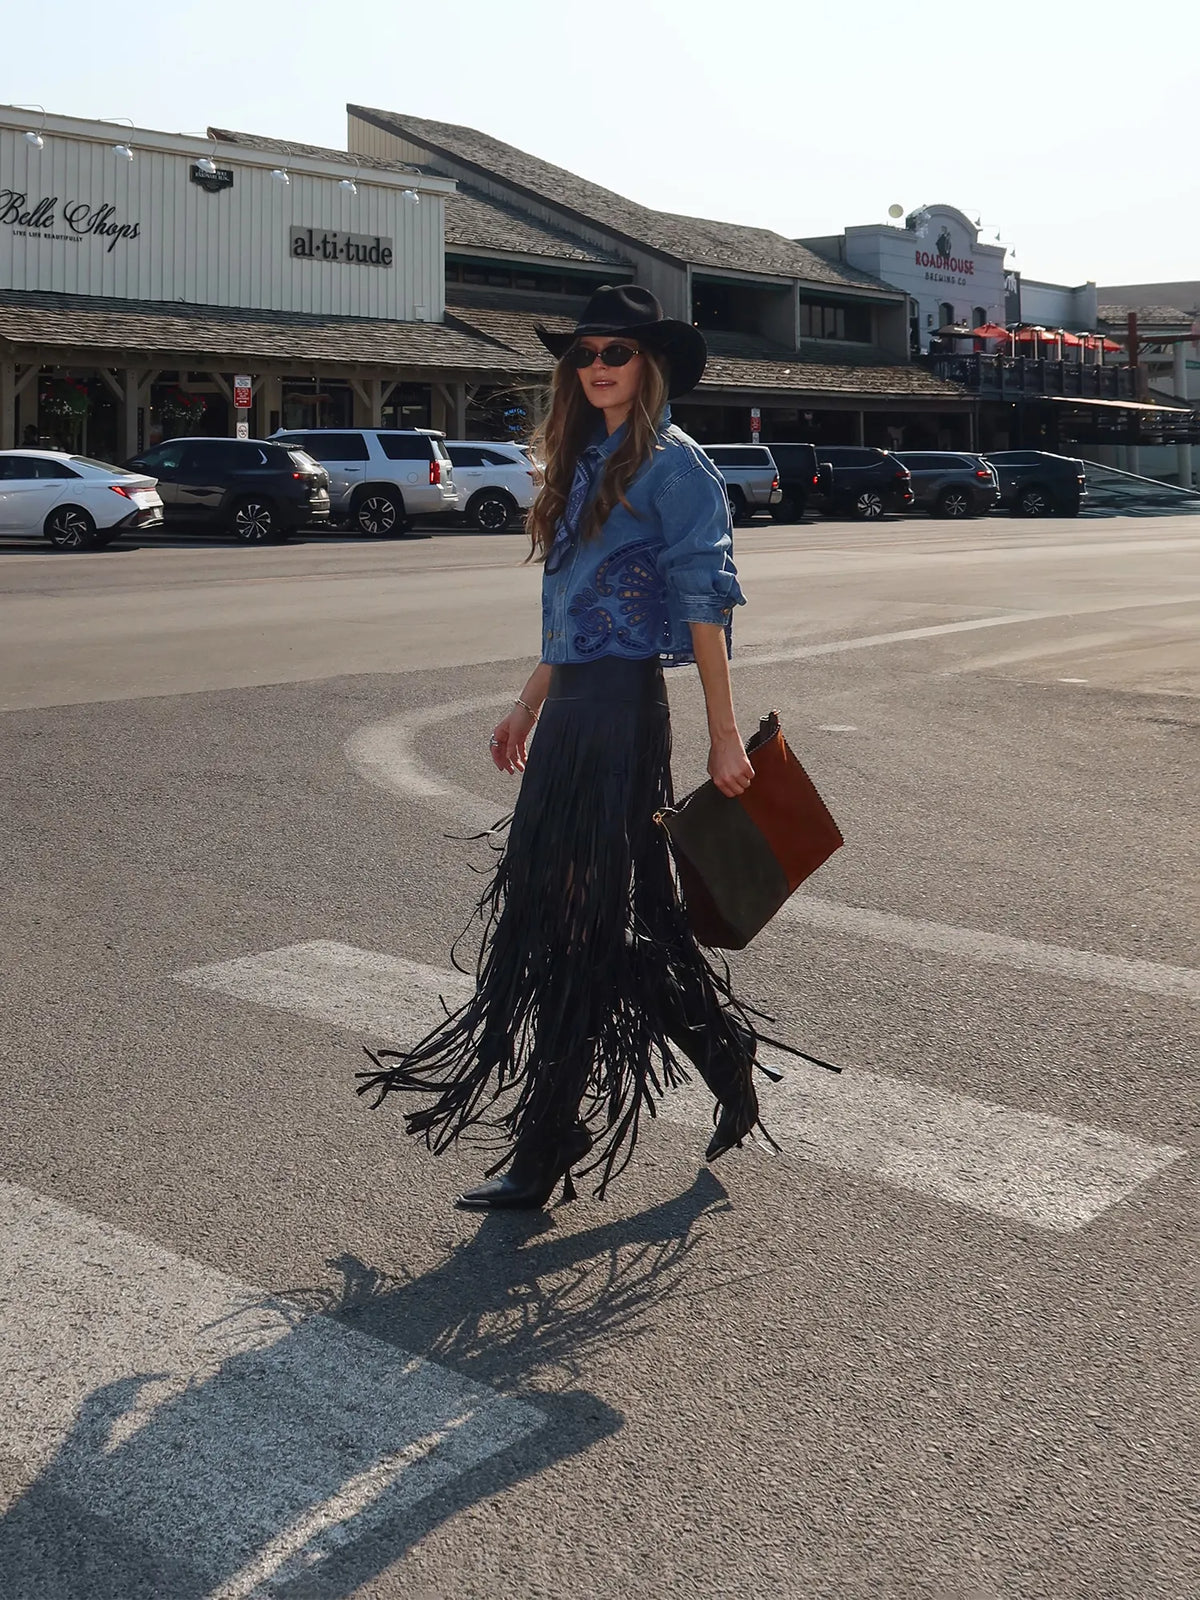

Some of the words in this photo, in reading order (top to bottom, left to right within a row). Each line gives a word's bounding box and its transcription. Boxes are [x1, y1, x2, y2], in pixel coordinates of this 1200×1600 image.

[0, 189, 58, 228] Belle
[64, 200, 140, 253] Shops
[44, 233, 82, 242] BEAUTIFULLY
[915, 250, 974, 275] ROADHOUSE
[925, 271, 956, 284] BREWING
[957, 277, 966, 286] CO
